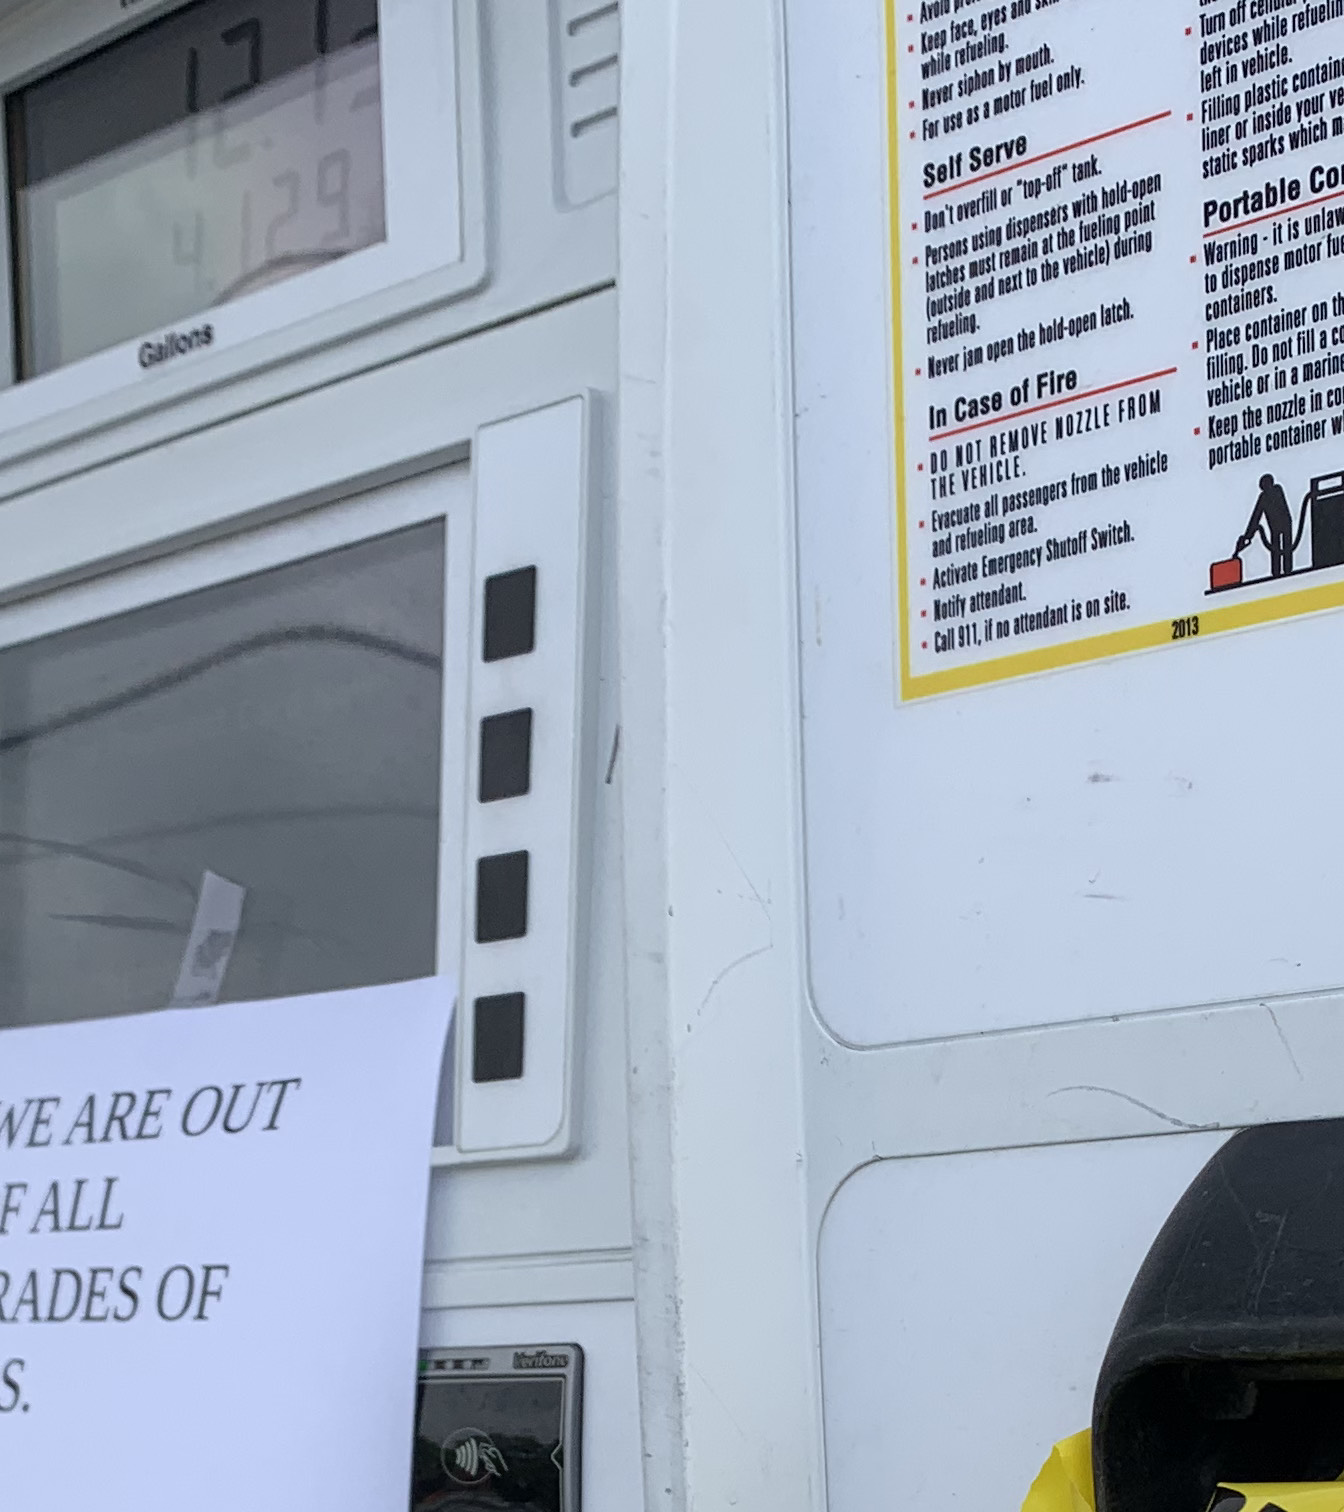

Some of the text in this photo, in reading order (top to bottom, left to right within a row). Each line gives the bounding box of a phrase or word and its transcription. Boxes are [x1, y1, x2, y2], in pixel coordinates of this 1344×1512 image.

[922, 136, 1027, 188] Self Serve
[1203, 179, 1301, 227] Portable
[139, 323, 214, 369] Gallons
[1206, 326, 1240, 352] Place
[1244, 307, 1307, 341] container
[1311, 301, 1328, 323] on
[929, 370, 1077, 430] In Case of Fire
[1208, 414, 1238, 439] Keep
[1242, 406, 1262, 430] the
[1266, 394, 1306, 424] nozzle
[1310, 389, 1322, 413] in
[930, 390, 1161, 474] DO NOT REMOVE NOZZLE FROM
[1208, 433, 1261, 468] portable
[1265, 419, 1327, 450] container
[931, 455, 1026, 500] THE VEHICLE.
[932, 521, 1135, 589] Activate Emergency Shutoff Switch.
[933, 582, 1026, 621] Notify attendant.
[934, 590, 1130, 653] Call 911, if no attendant is on site.
[1170, 615, 1200, 640] 2013
[62, 1088, 171, 1145] ARE
[181, 1077, 301, 1136] OUT
[29, 1176, 125, 1234] ALL
[155, 1264, 230, 1321] OF
